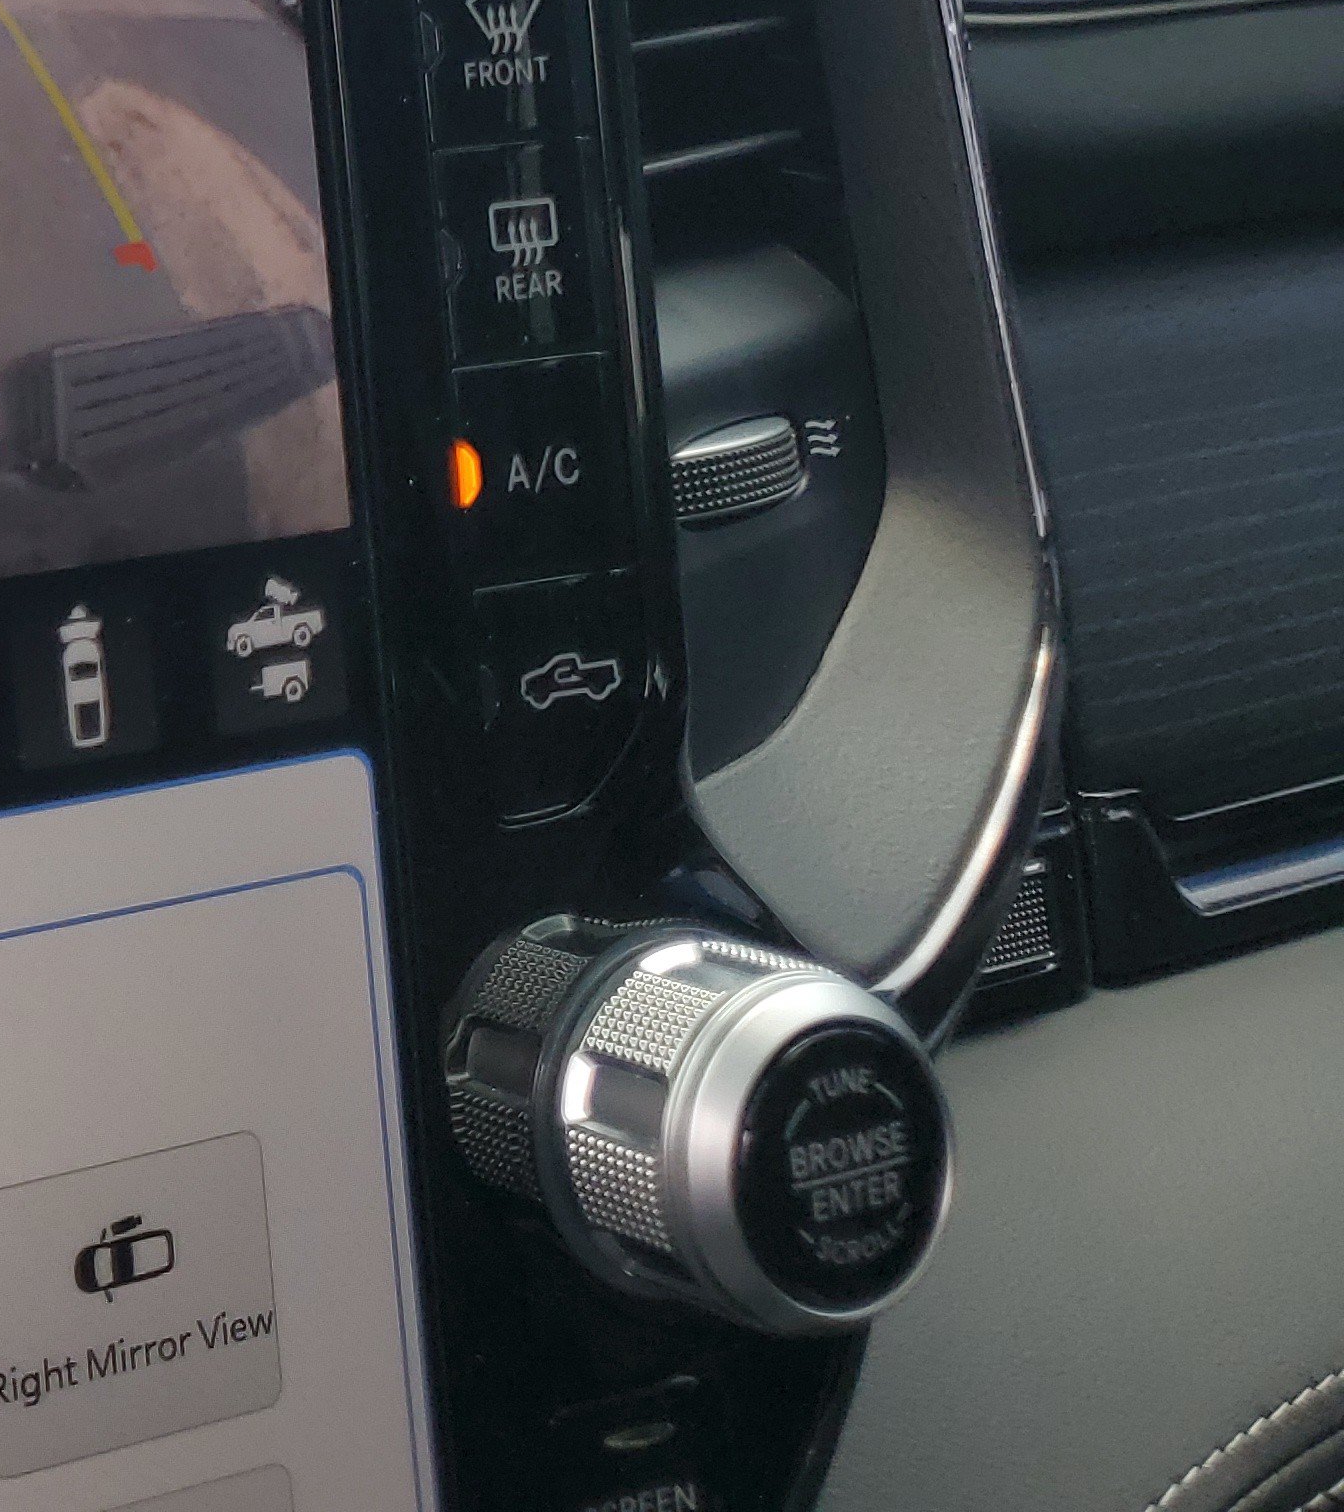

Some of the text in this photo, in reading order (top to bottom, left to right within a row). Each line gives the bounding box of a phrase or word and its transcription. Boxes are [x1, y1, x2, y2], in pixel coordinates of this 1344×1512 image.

[463, 55, 550, 90] FRONT
[495, 269, 564, 304] REAR
[507, 445, 580, 494] A/C
[809, 1067, 873, 1104] TUNE
[789, 1120, 908, 1180] BROWSE
[812, 1170, 901, 1223] ENTER
[86, 1337, 191, 1381] Mirror
[196, 1310, 273, 1349] View
